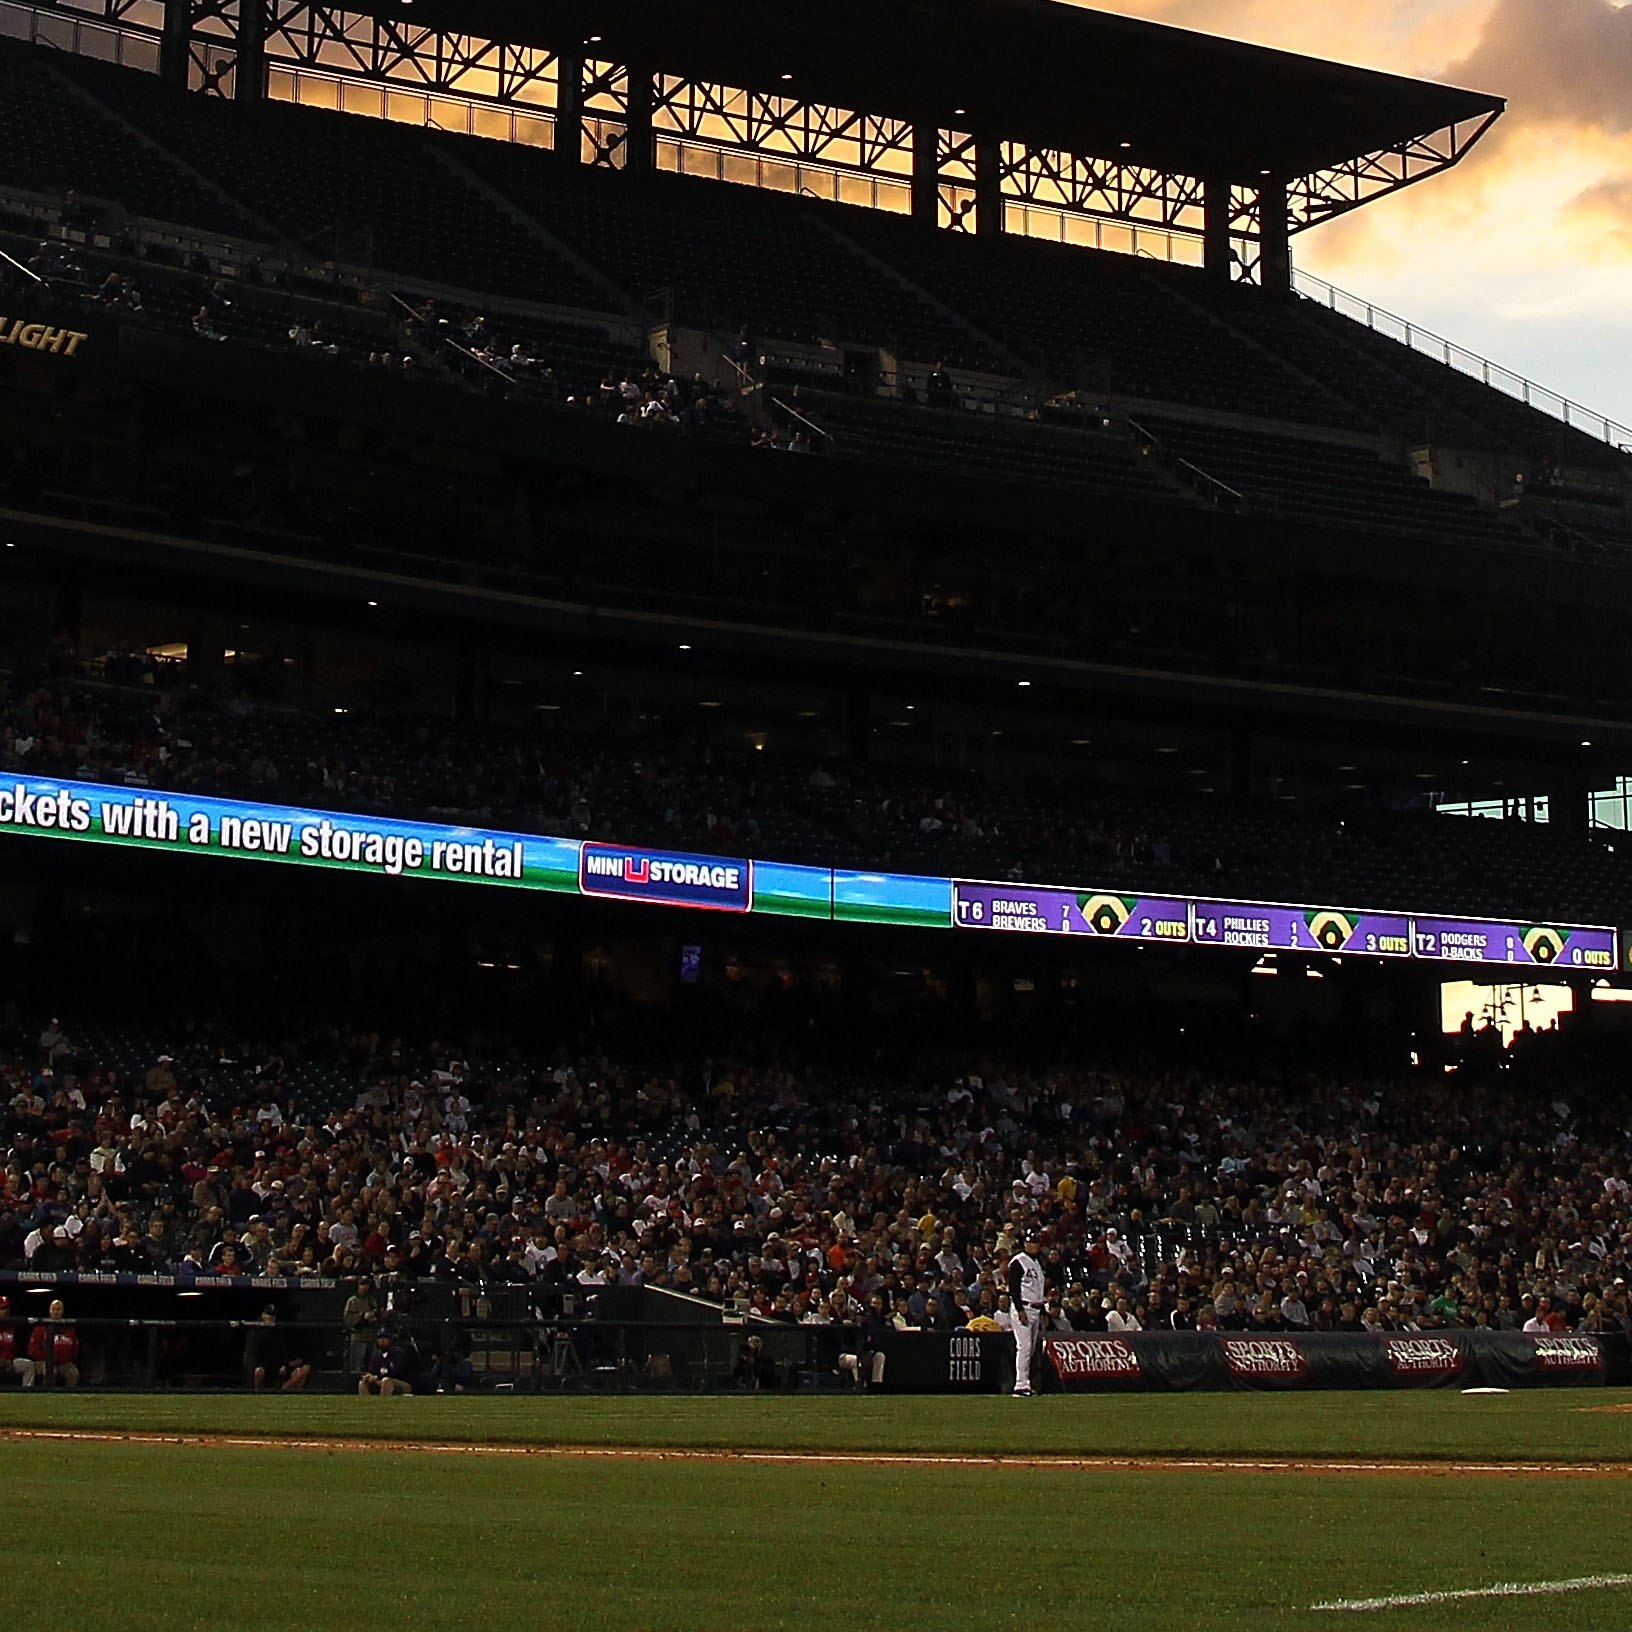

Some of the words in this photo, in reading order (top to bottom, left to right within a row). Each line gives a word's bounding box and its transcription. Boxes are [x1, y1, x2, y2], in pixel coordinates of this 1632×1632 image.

[102, 798, 178, 842] with
[188, 814, 209, 844] a
[221, 817, 292, 850] new
[301, 820, 422, 872] storage
[431, 839, 523, 878] rental
[587, 855, 624, 877] MINI
[650, 863, 740, 889] STORAGE
[992, 900, 1037, 915] BRAVES
[1062, 905, 1070, 917] 7
[992, 915, 1047, 930] BREWERS
[1141, 918, 1152, 936] 2
[1155, 921, 1186, 937] OUTS
[1196, 918, 1217, 937] T4
[1224, 917, 1270, 932] PHILLIES
[1291, 922, 1297, 934] 1
[1224, 932, 1269, 946] ROCKIES
[1290, 935, 1298, 947] 2
[1366, 934, 1377, 951] 3
[1379, 936, 1407, 952] OUTS
[1416, 933, 1436, 952] T2
[1441, 931, 1487, 948] DODGERS
[1441, 946, 1483, 961] D-BACKS
[1572, 949, 1582, 964] 0
[1584, 950, 1611, 965] OUTS
[949, 1337, 981, 1358] COORS
[1052, 1340, 1130, 1359] SPORTS
[1226, 1341, 1298, 1359] SPORTS
[949, 1360, 981, 1381] FIELD
